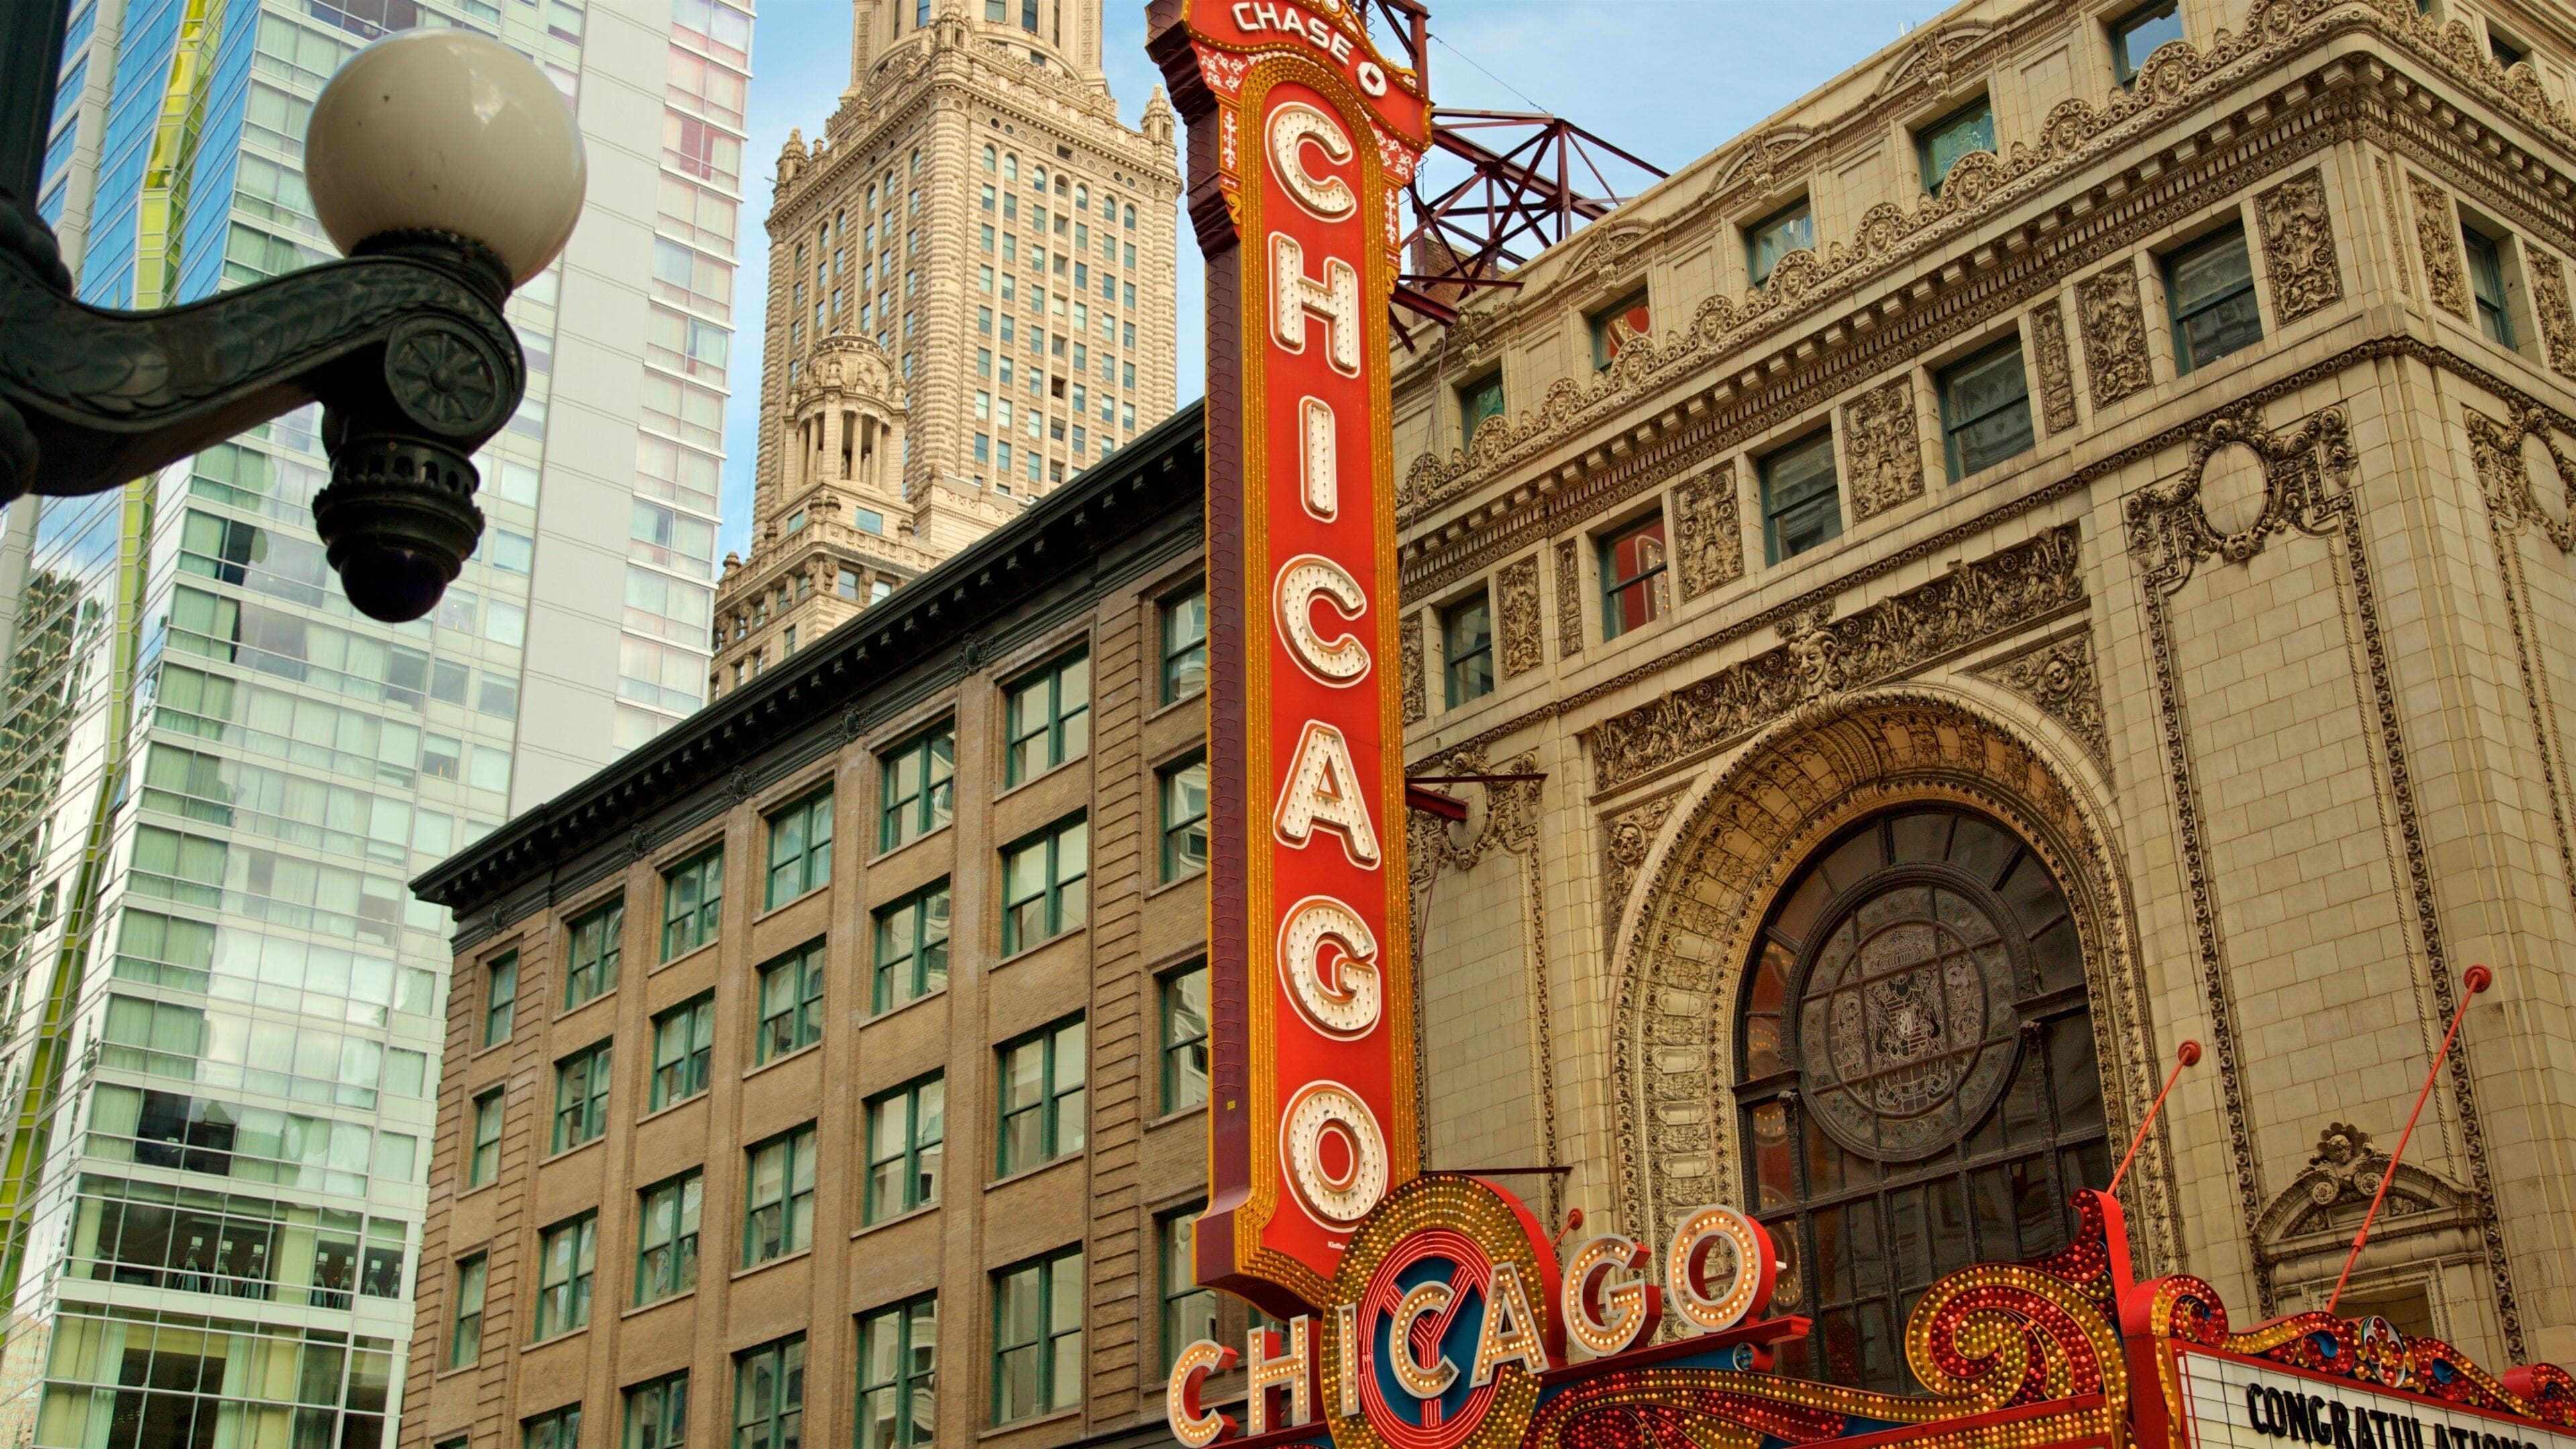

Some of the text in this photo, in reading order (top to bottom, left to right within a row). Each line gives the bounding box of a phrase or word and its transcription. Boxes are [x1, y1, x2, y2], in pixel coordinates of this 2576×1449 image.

[1232, 2, 1354, 65] CHASE
[1265, 101, 1388, 1232] CHICAGO
[1167, 1203, 1762, 1448] CHICAGO
[2247, 1383, 2538, 1449] CONGRATULA
